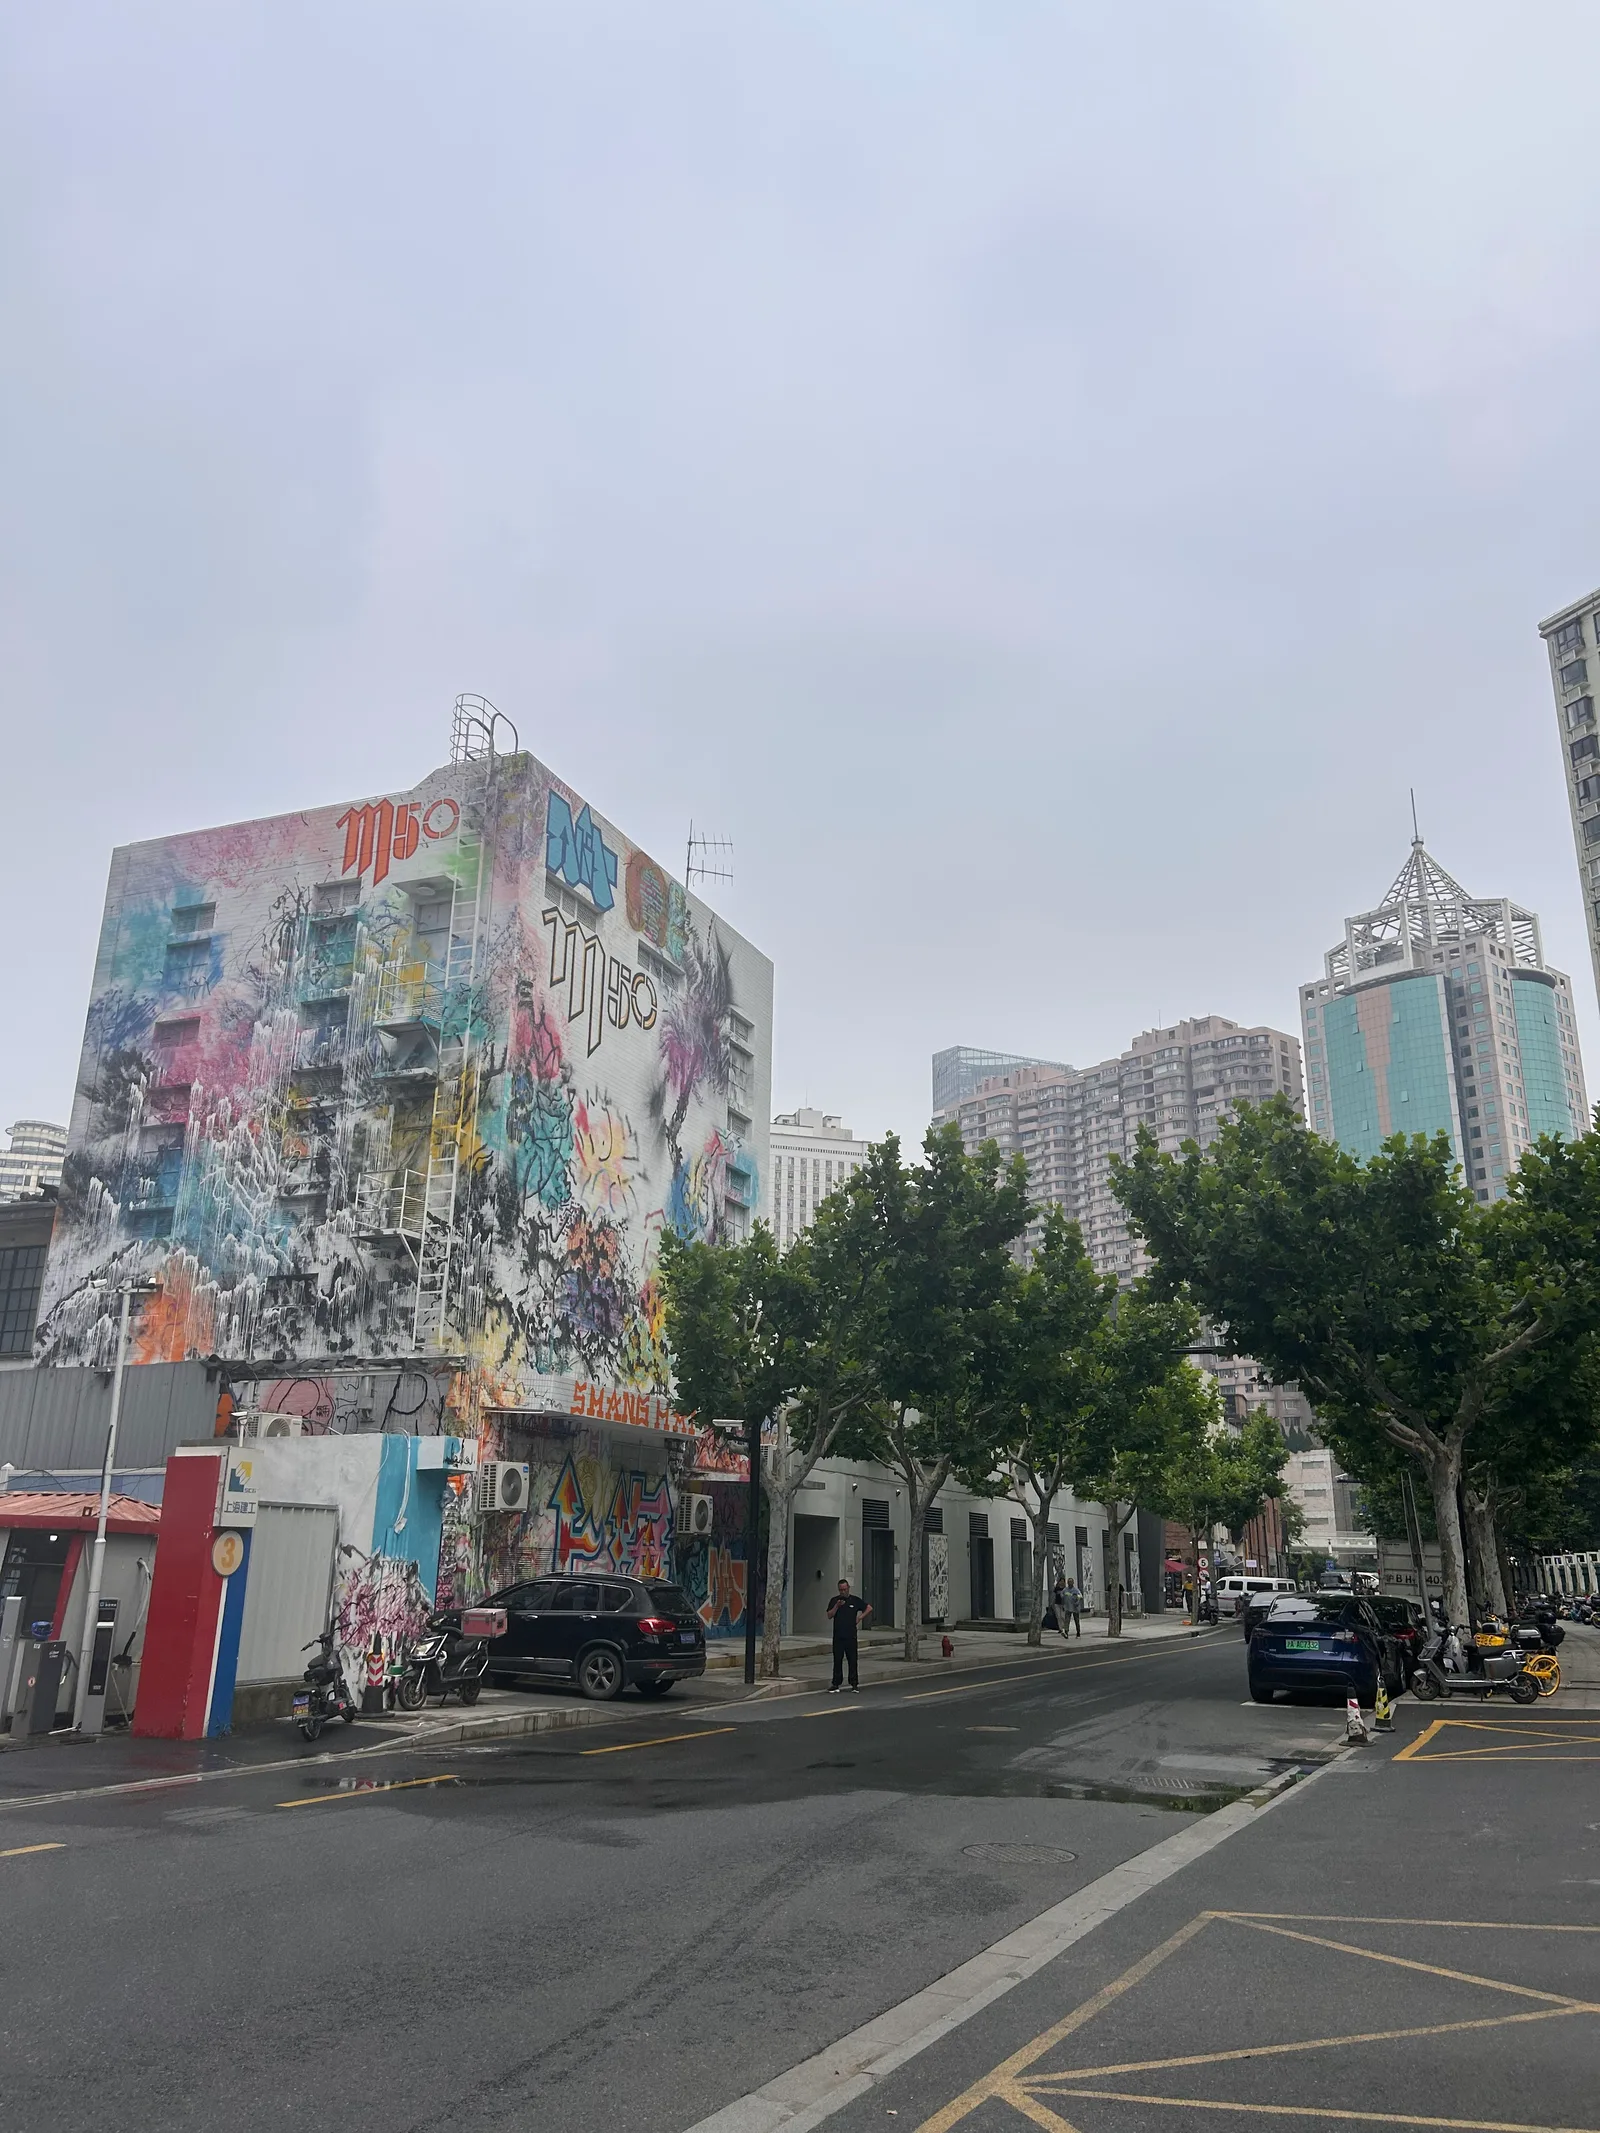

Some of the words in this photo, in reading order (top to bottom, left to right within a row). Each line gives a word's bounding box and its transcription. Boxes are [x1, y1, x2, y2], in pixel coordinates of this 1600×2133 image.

[224, 1501, 256, 1514] 上海建工
[221, 1537, 236, 1569] 3
[1201, 1559, 1206, 1567] 5
